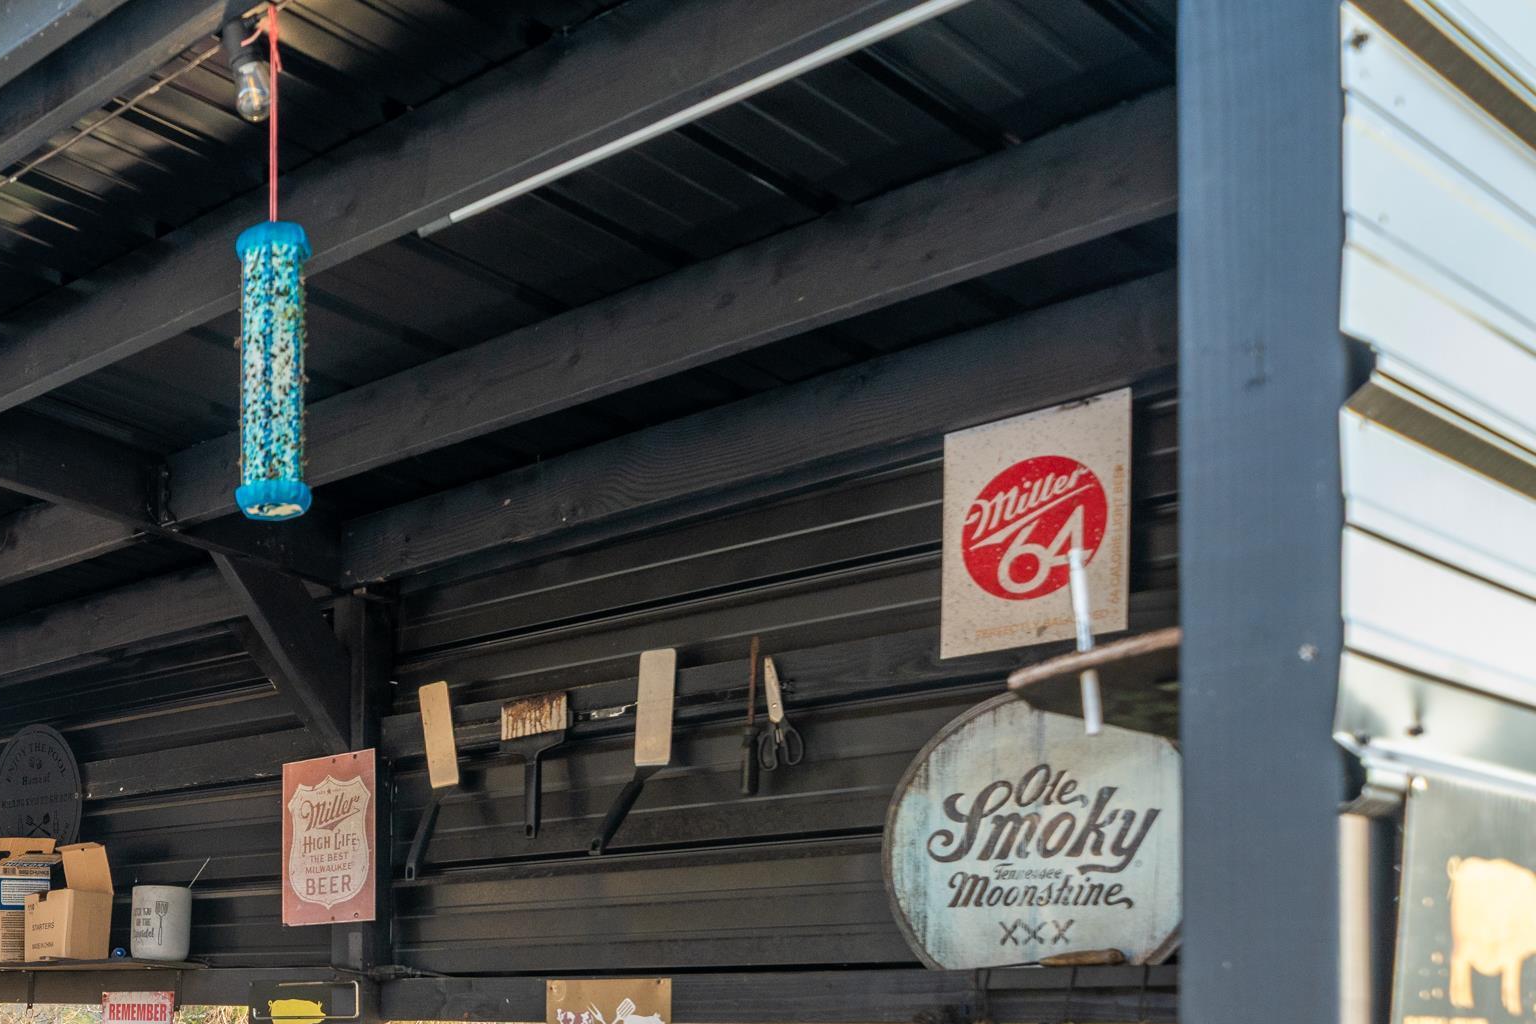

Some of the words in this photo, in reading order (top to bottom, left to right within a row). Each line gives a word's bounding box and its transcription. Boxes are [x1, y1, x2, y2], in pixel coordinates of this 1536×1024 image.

[964, 466, 1091, 541] Miller
[997, 505, 1094, 594] 64
[1016, 763, 1088, 808] Ole
[301, 792, 360, 832] Miller
[927, 780, 1161, 875] Smoky
[302, 836, 331, 857] HIGH
[335, 829, 360, 851] LIFE
[306, 862, 352, 874] MILWAUKEE
[310, 855, 324, 863] THE
[327, 852, 348, 862] BEST
[994, 863, 1064, 880] Tennessee
[306, 875, 351, 895] BEER
[948, 871, 1134, 909] Moonshine
[32, 921, 55, 931] STARTERS
[109, 1003, 167, 1022] REMEMBER
